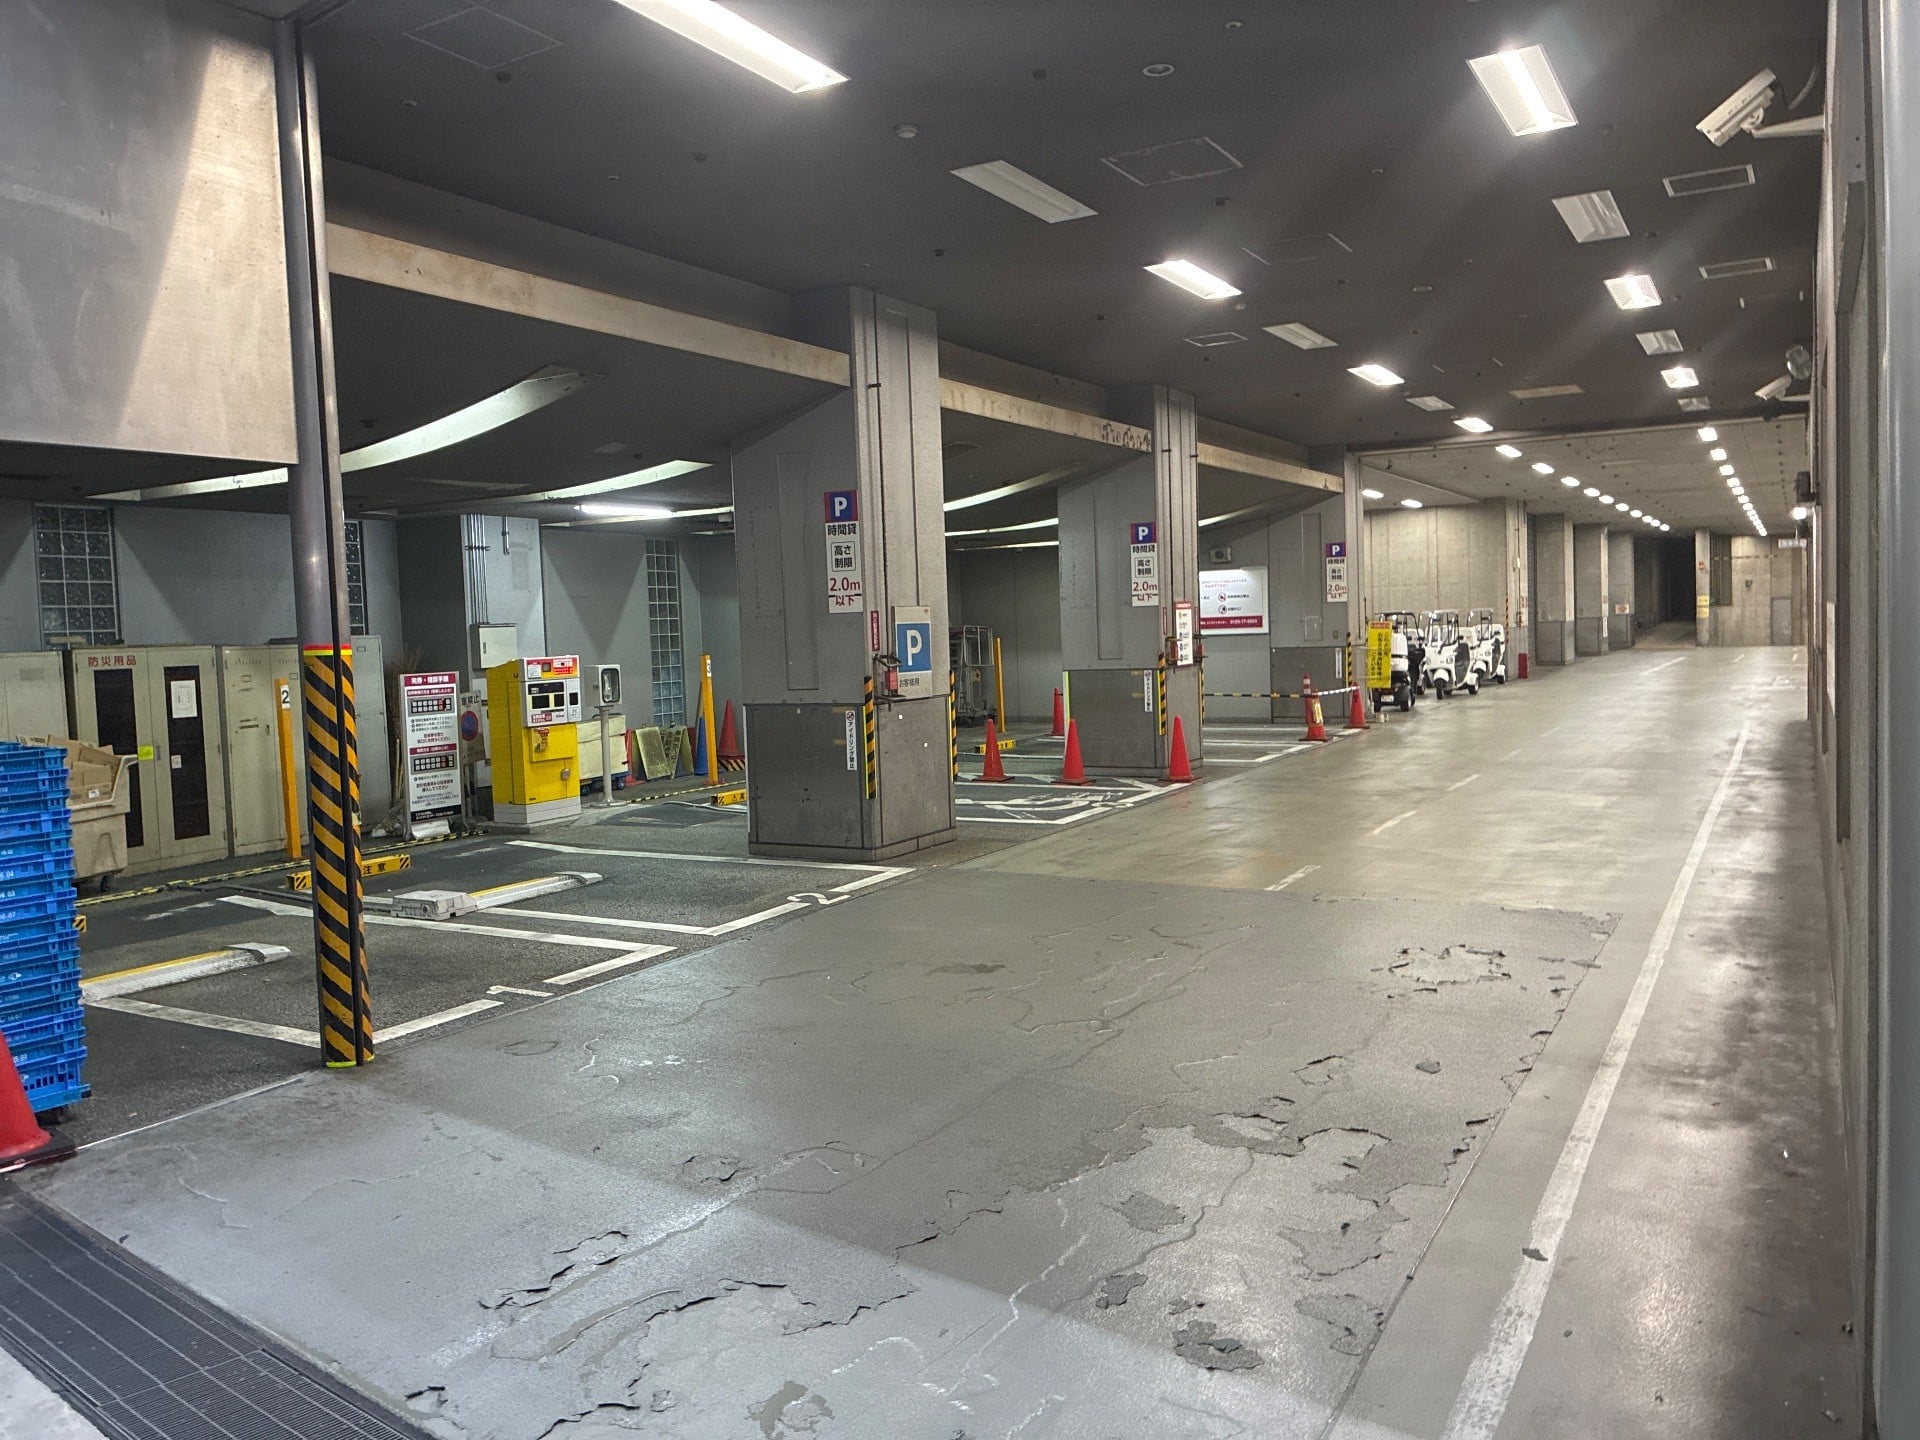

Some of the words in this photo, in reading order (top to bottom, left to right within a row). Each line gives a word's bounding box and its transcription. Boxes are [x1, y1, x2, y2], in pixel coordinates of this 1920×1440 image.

[834, 497, 848, 517] P
[827, 523, 857, 536] 時間貸
[1138, 526, 1149, 541] P
[834, 545, 852, 557] 高さ
[1331, 544, 1341, 556] P
[834, 557, 853, 569] 制限
[829, 577, 861, 592] 2.0m
[1133, 581, 1157, 592] 2.0m
[834, 594, 855, 607] 以下
[907, 629, 922, 666] P
[87, 655, 137, 668] 防災用品
[281, 689, 290, 704] 2
[847, 721, 856, 769] アイドリング禁止
[362, 862, 386, 875] 注意
